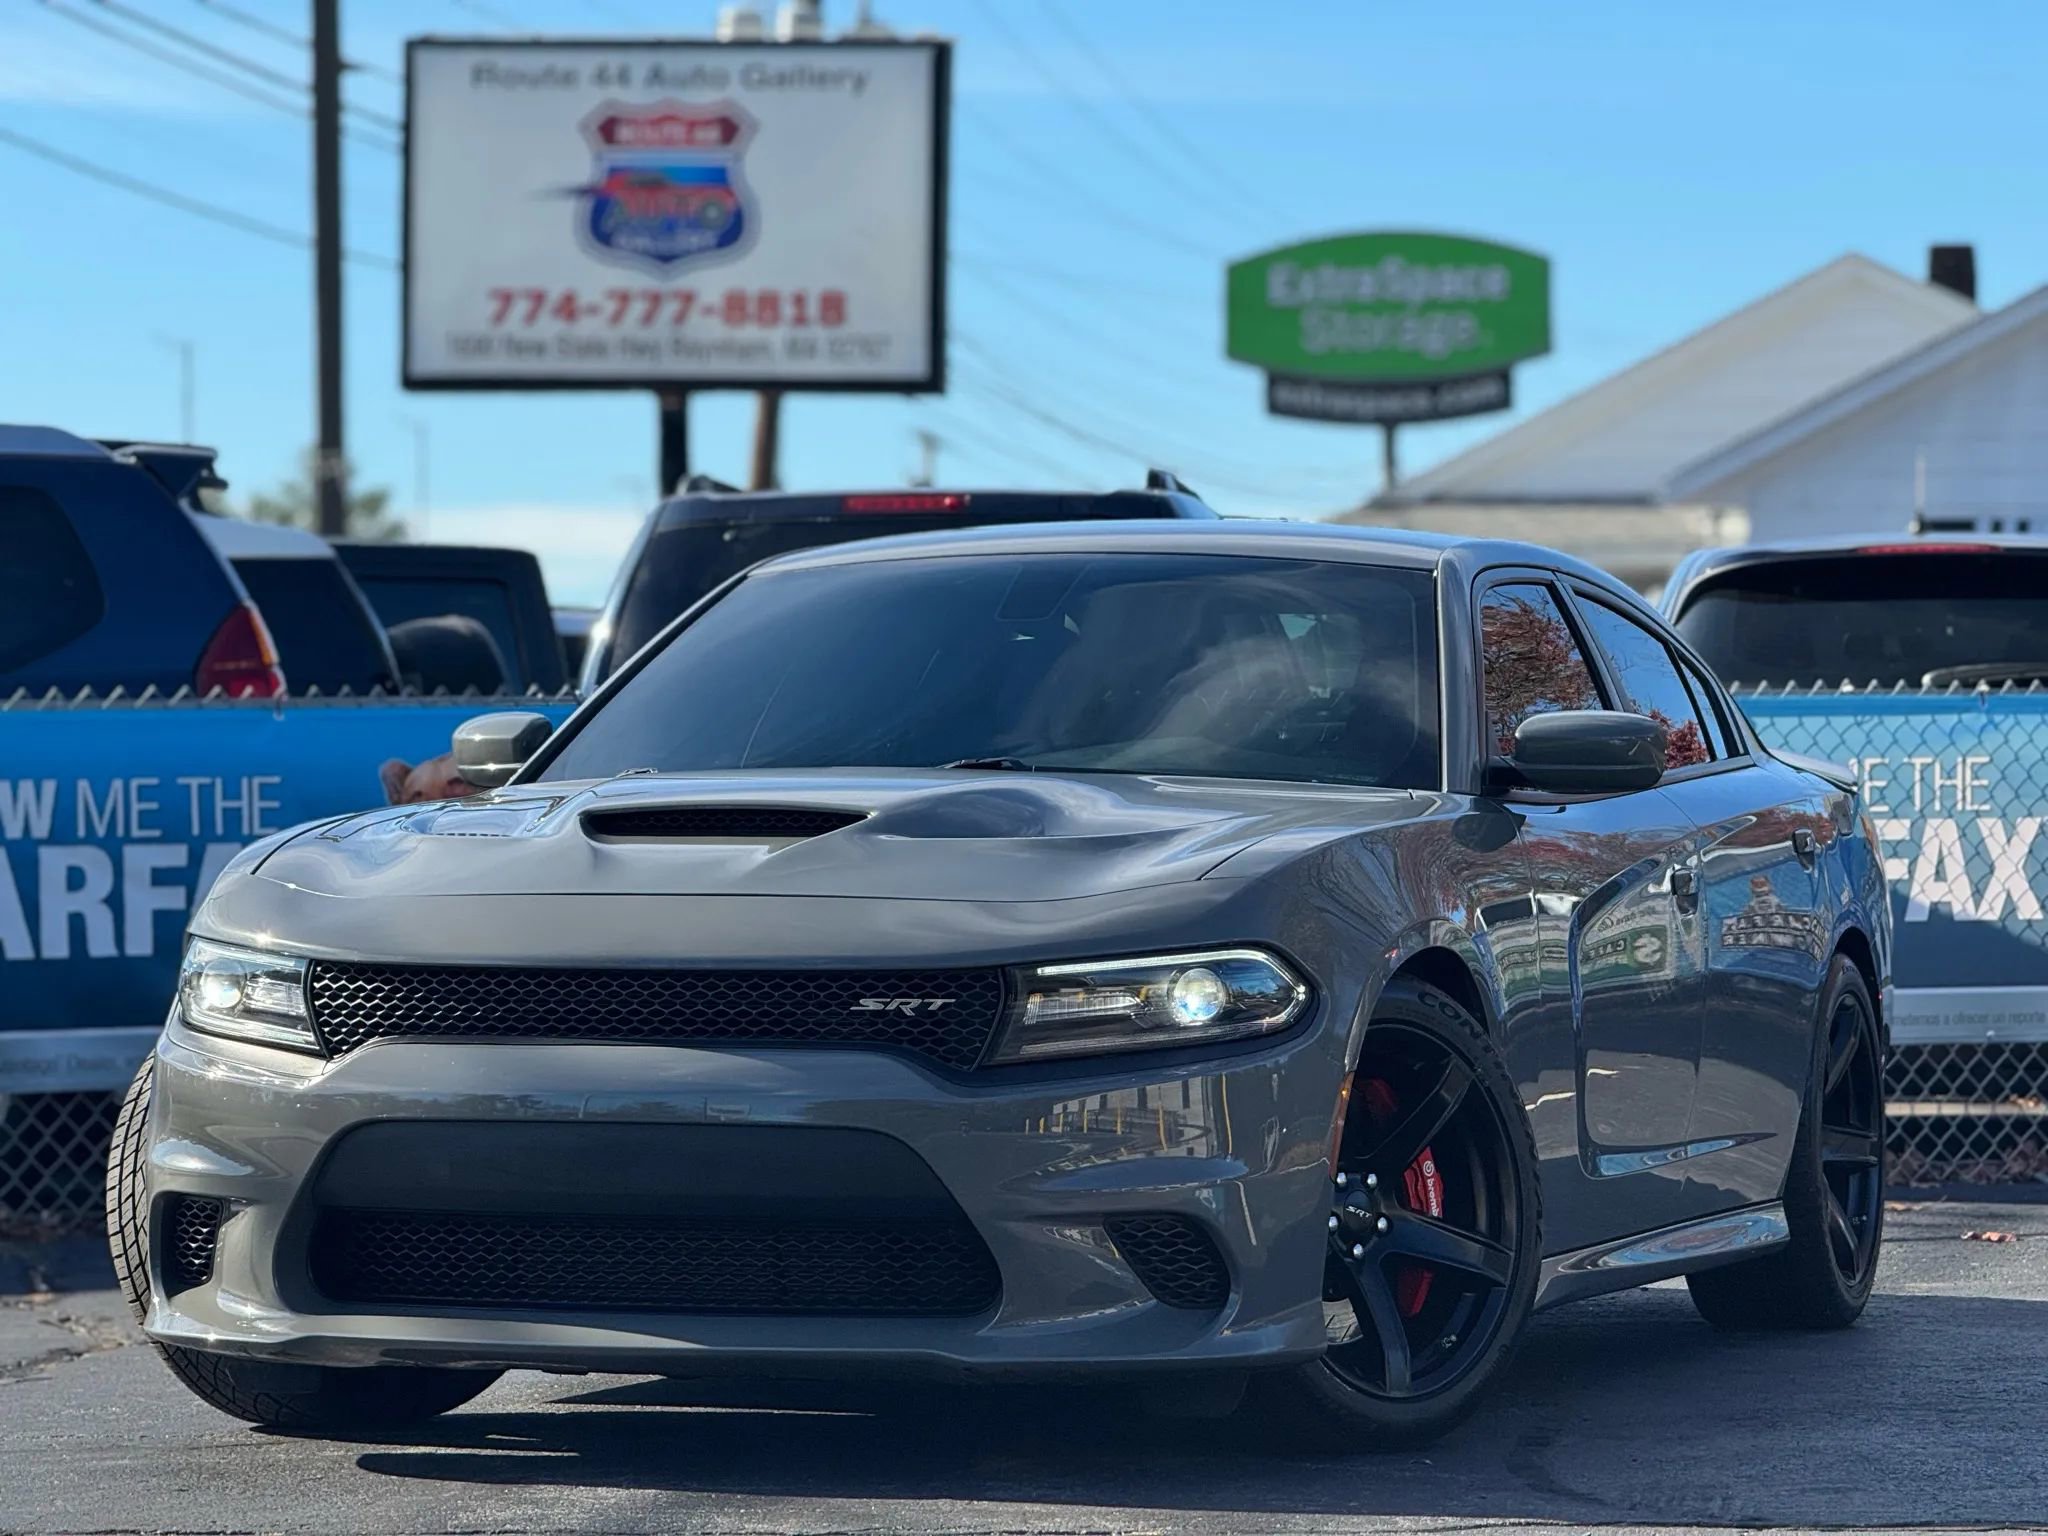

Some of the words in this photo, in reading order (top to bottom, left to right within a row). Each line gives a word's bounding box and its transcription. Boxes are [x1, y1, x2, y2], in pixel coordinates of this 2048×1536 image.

[470, 62, 578, 89] Route
[590, 63, 632, 89] 44
[646, 62, 729, 89] Auto
[740, 62, 870, 96] Gallery
[1848, 757, 1889, 812] E
[1904, 757, 1991, 811] THE
[77, 777, 162, 838] ME
[177, 776, 281, 836] THE
[850, 998, 956, 1016] SRT
[1345, 1205, 1372, 1218] SRT
